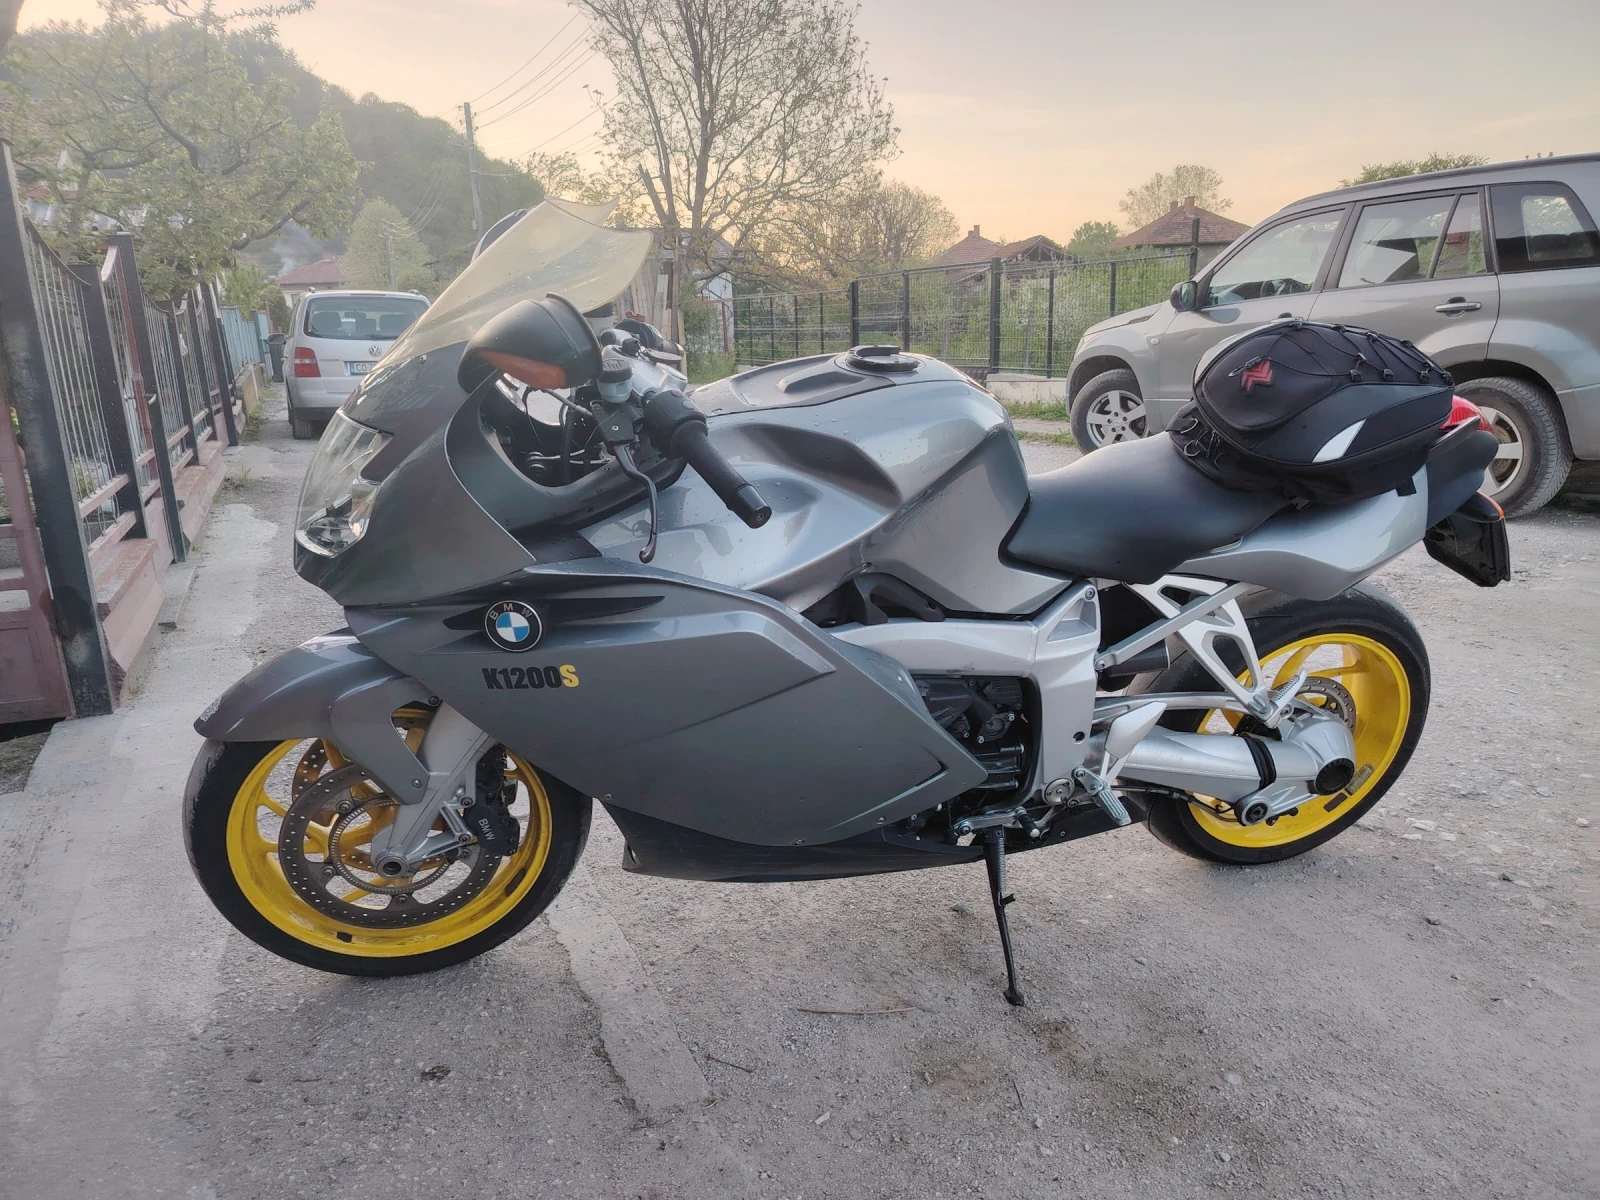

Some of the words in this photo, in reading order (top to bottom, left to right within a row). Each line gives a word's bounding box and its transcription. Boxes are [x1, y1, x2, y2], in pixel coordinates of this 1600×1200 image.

[368, 344, 382, 357] VW
[489, 603, 533, 620] BMW
[481, 664, 579, 689] K1200S
[478, 818, 496, 840] BMW
